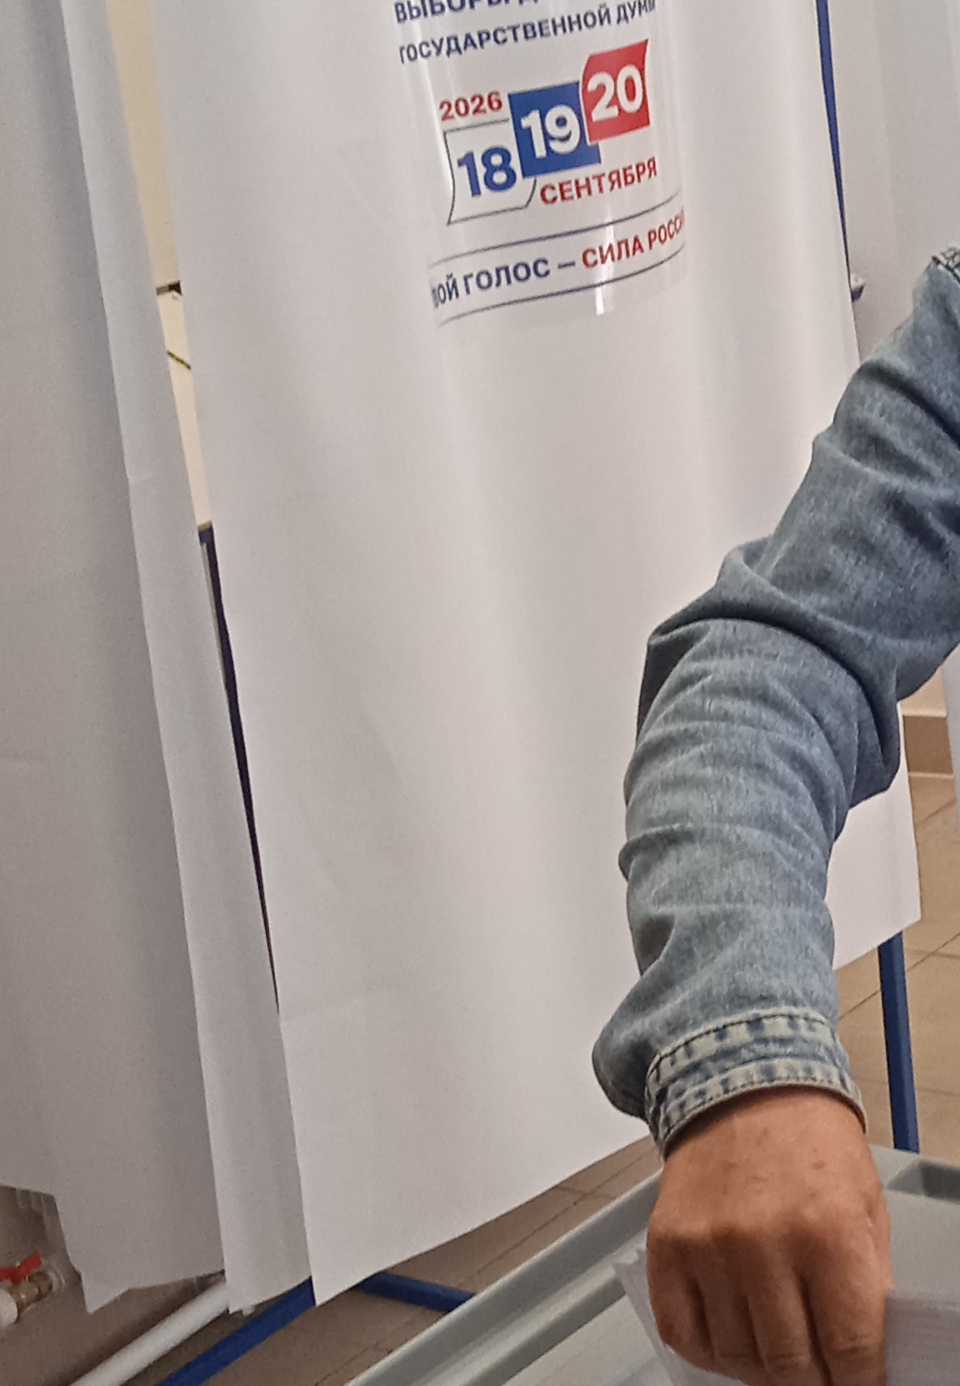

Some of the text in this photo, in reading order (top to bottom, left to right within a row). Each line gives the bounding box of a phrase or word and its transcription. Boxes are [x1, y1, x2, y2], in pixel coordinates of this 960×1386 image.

[399, 2, 612, 64] ГОСУДАРСТВЕННОЙ
[439, 90, 503, 122] 2026
[456, 63, 645, 198] 18 19 20
[539, 156, 658, 205] СЕНТЯБРЯ
[463, 257, 551, 295] ГОЛОС
[581, 234, 645, 270] СИЛА
